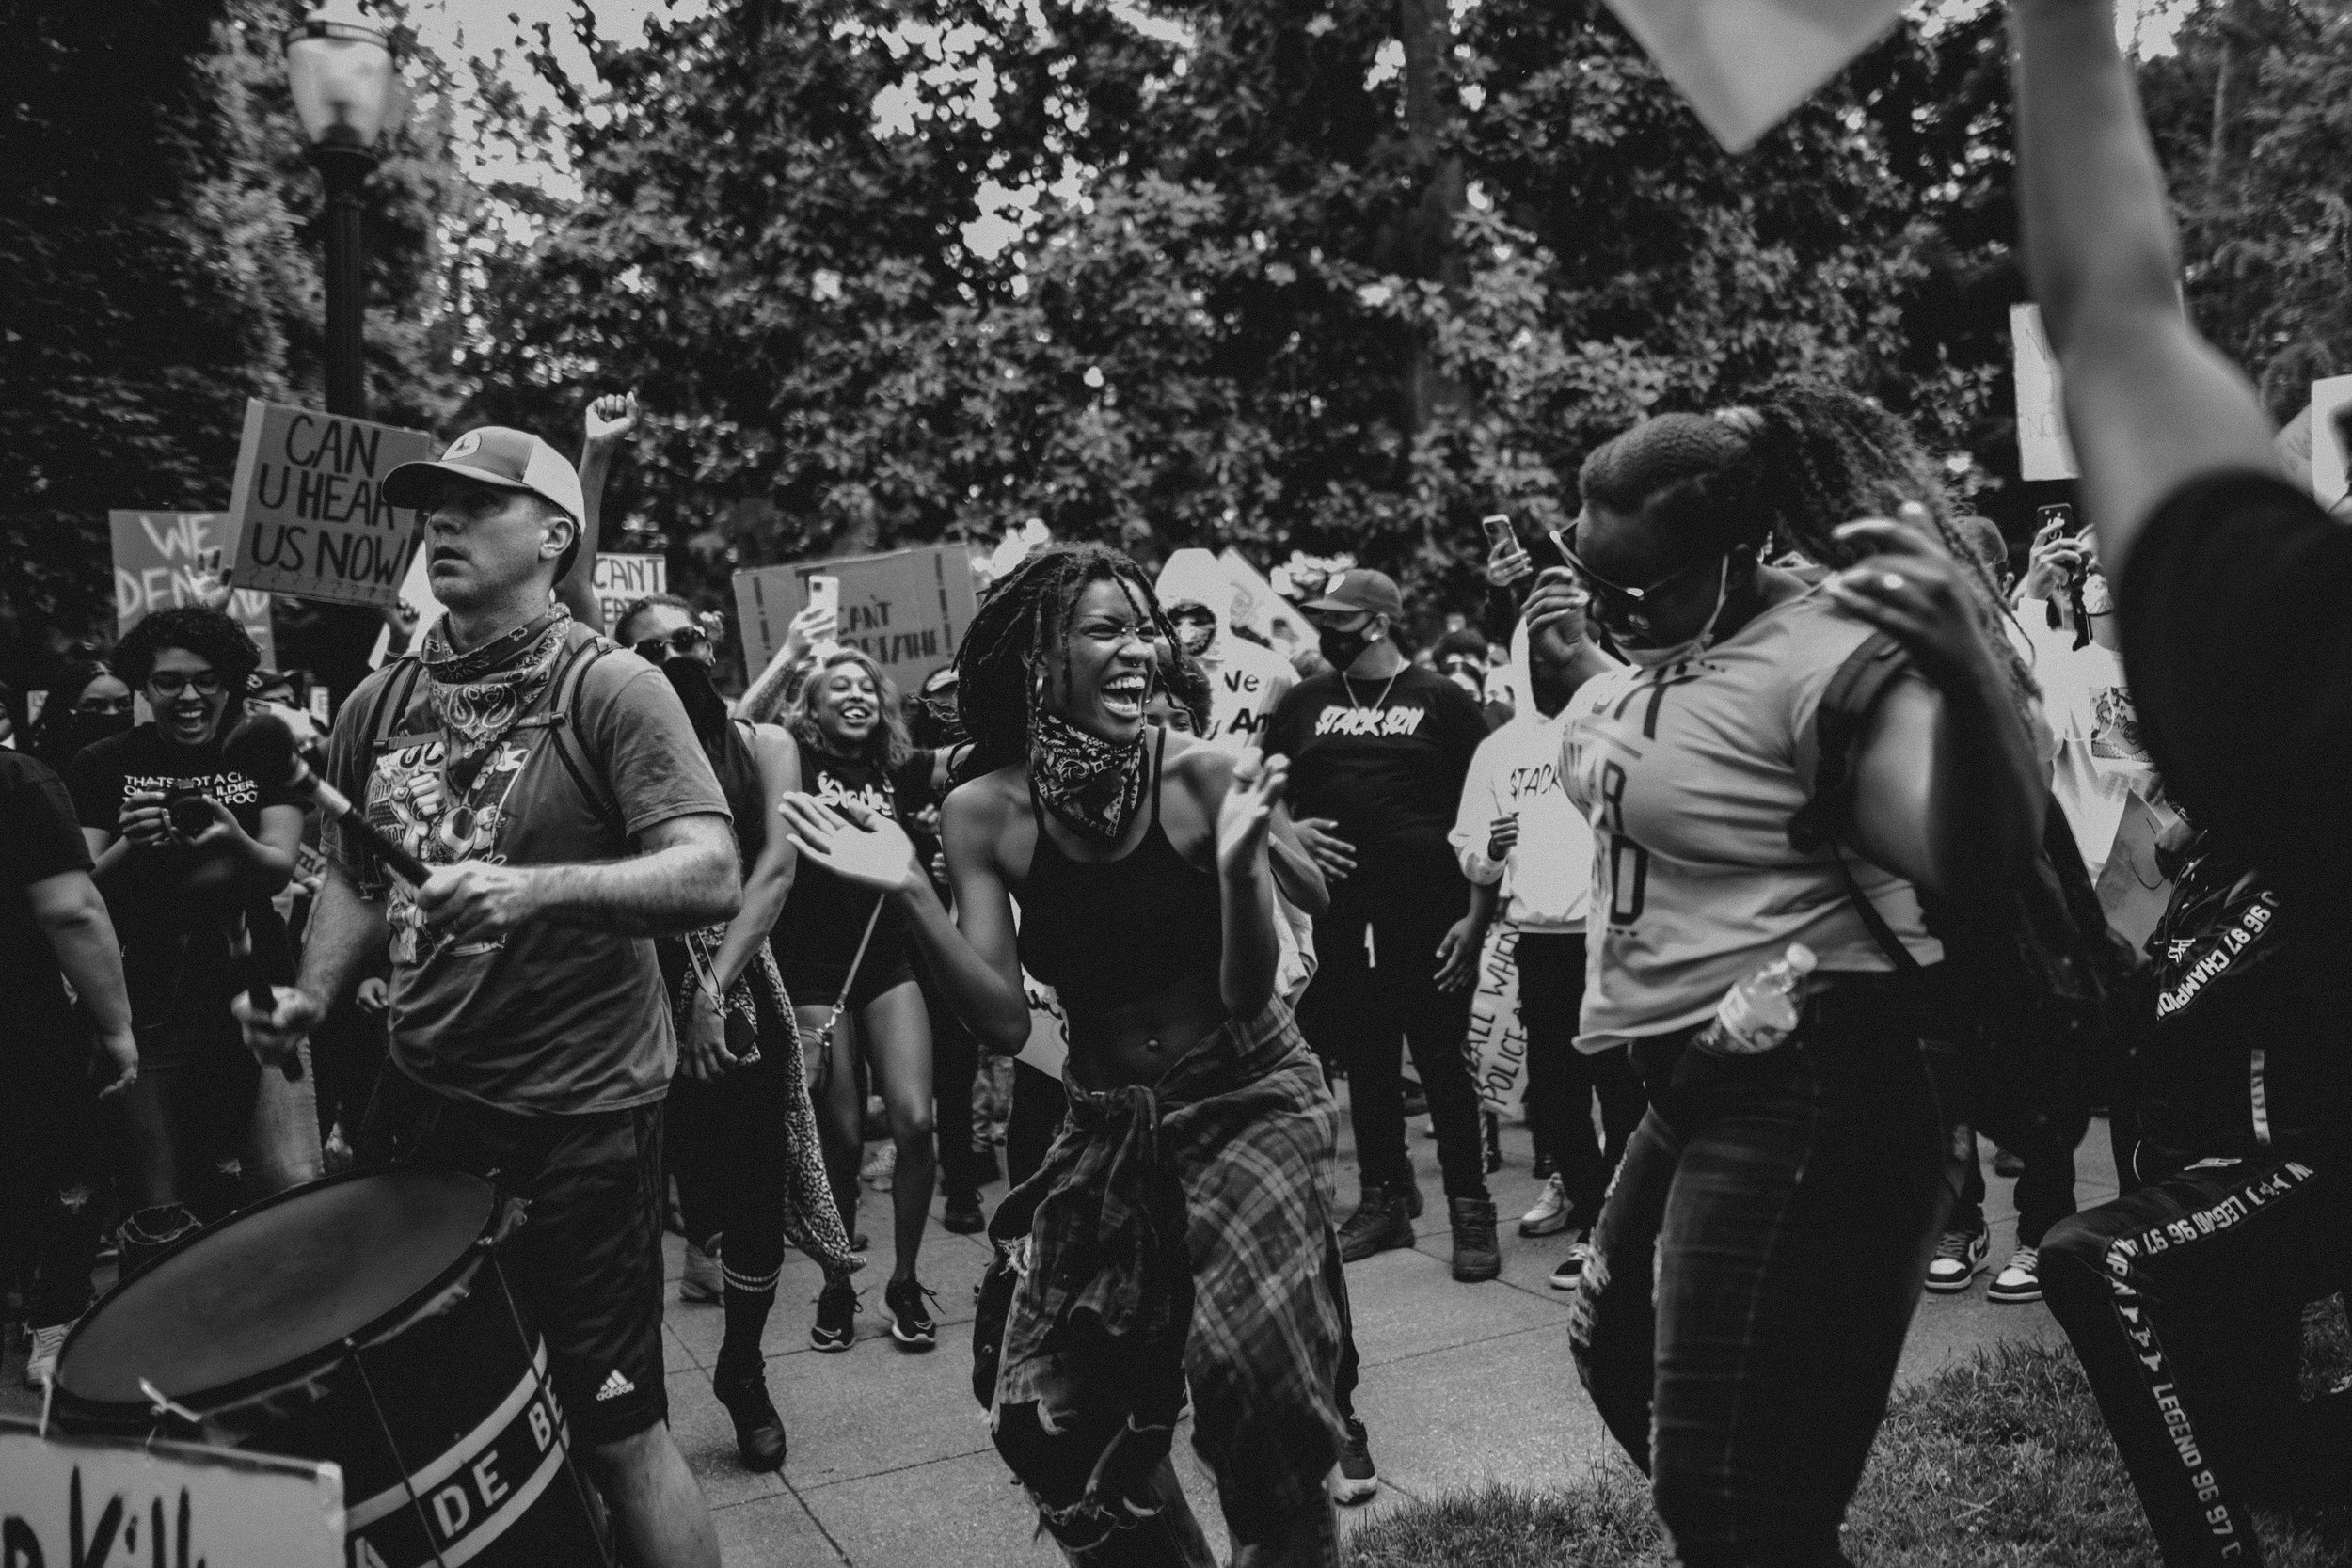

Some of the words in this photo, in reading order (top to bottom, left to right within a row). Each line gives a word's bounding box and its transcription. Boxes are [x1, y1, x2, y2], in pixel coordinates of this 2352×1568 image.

[286, 414, 380, 478] CAN
[258, 462, 291, 510] U
[140, 514, 225, 561] WE
[251, 522, 307, 572] US
[314, 530, 406, 586] NOW
[214, 773, 226, 784] A
[2239, 904, 2272, 934] 96
[2152, 1382, 2202, 1468] LEGEND
[432, 1449, 510, 1539] DE
[2191, 1469, 2220, 1503] 96
[2205, 1505, 2234, 1535] 97
